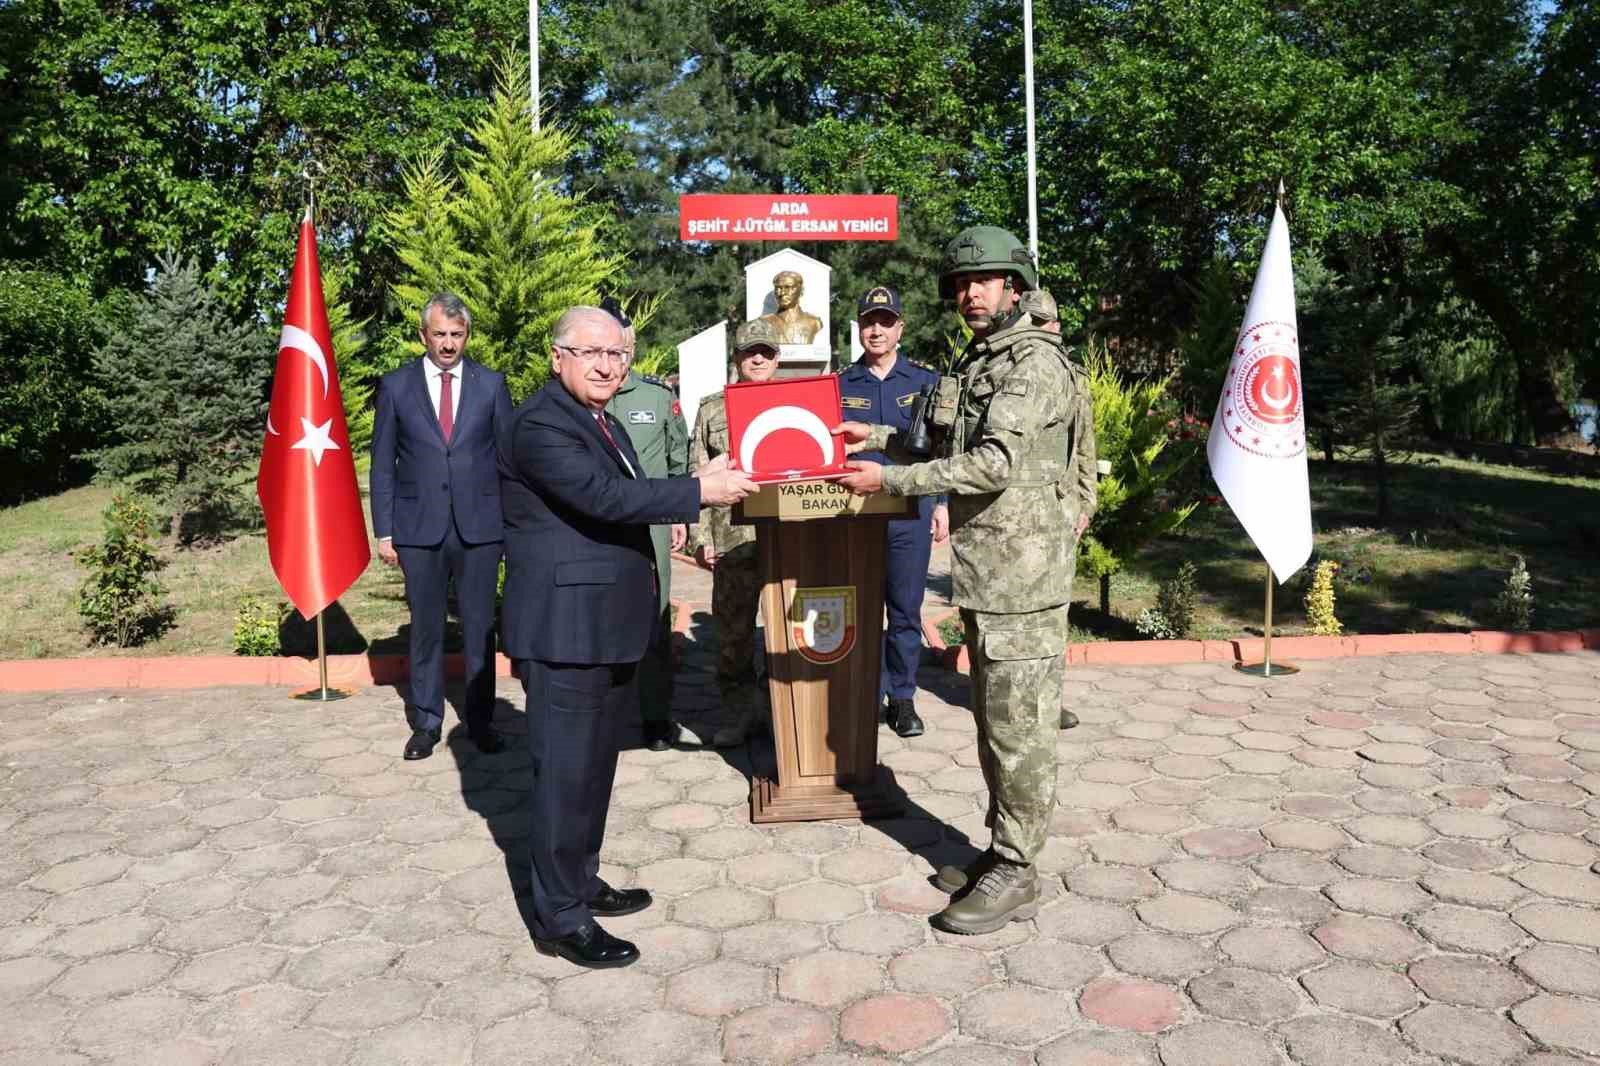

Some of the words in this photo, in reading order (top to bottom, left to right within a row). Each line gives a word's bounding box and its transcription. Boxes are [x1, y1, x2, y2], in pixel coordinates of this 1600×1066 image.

[770, 202, 809, 215] ARDA
[687, 217, 730, 236] ŞEHİT
[791, 219, 838, 233] ERSAN
[842, 217, 889, 233] YENİCİ
[780, 484, 823, 496] YAŞAR
[802, 499, 848, 510] BAKAN
